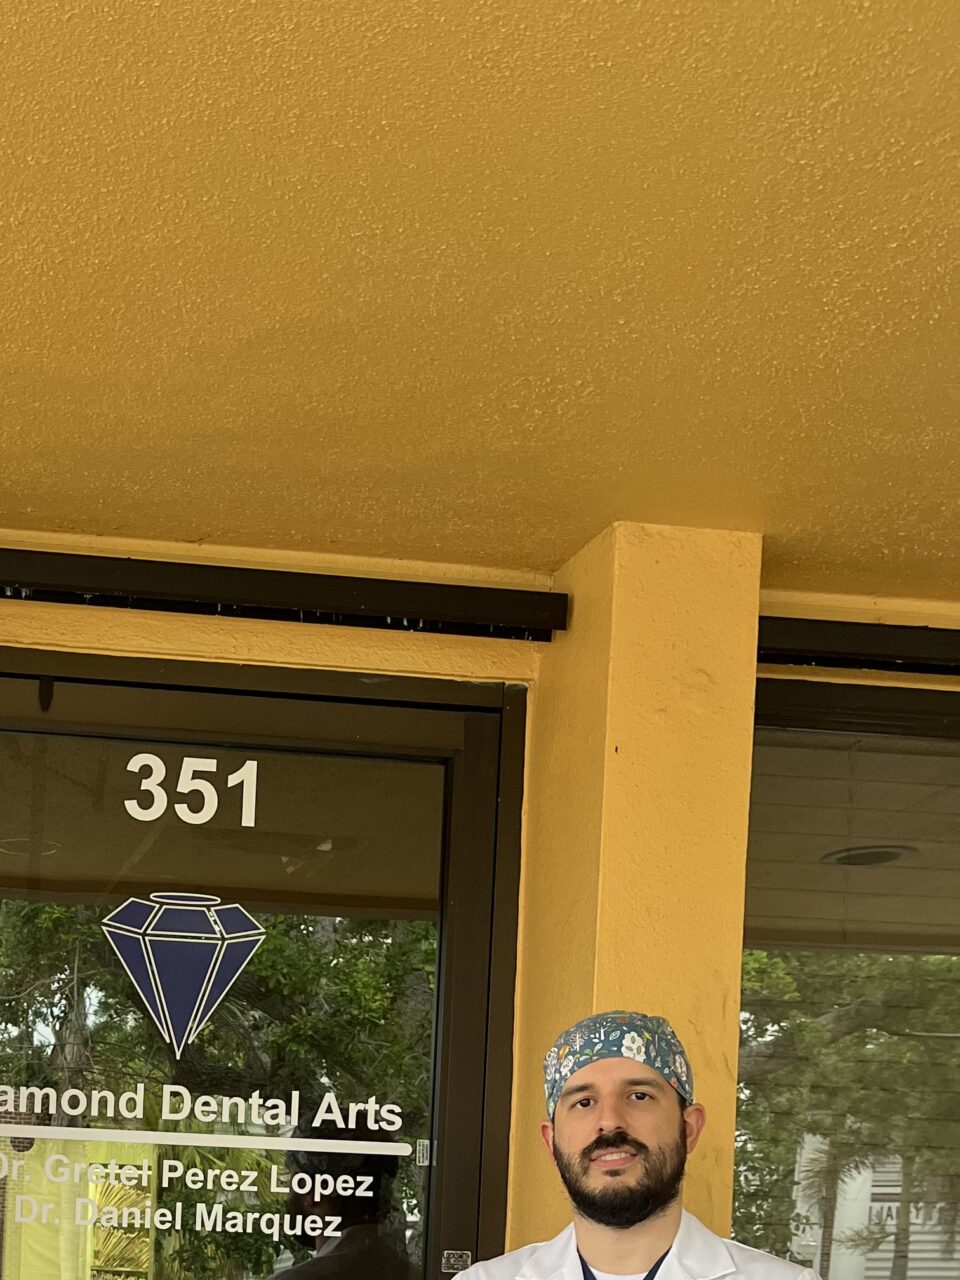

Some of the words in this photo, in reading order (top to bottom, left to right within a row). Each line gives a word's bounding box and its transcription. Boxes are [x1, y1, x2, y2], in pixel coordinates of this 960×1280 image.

[124, 753, 258, 828] 351
[161, 1084, 300, 1127] Dental
[311, 1092, 403, 1132] Arts
[44, 1154, 149, 1187] Gretel
[161, 1159, 258, 1192] Perez
[270, 1164, 374, 1202] Lopez
[14, 1195, 60, 1225] Dr.
[74, 1198, 183, 1230] Daniel
[195, 1203, 342, 1242] Marquez
